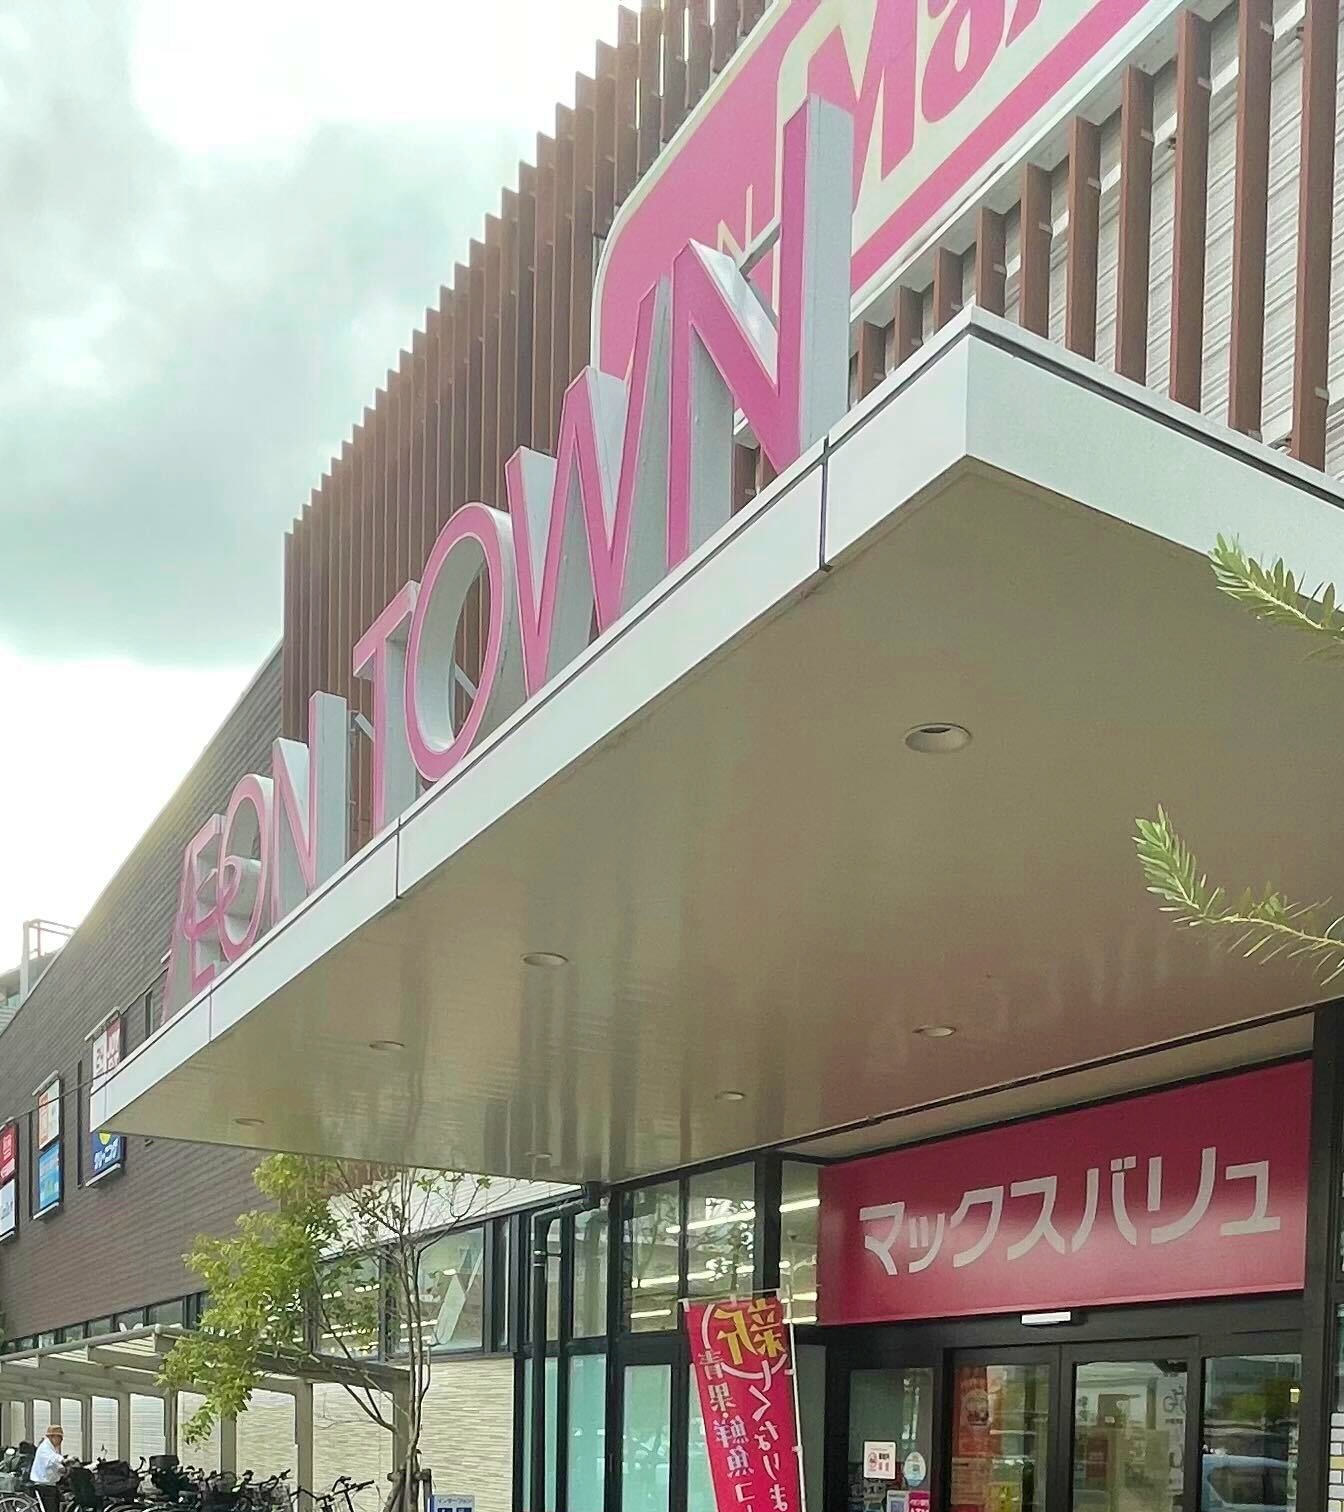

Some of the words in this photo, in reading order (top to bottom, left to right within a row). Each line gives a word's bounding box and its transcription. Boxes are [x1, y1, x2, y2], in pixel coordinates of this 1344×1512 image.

[162, 691, 346, 1025] AEON
[353, 94, 854, 835] TOWN
[859, 1147, 1281, 1276] マックスバリュ
